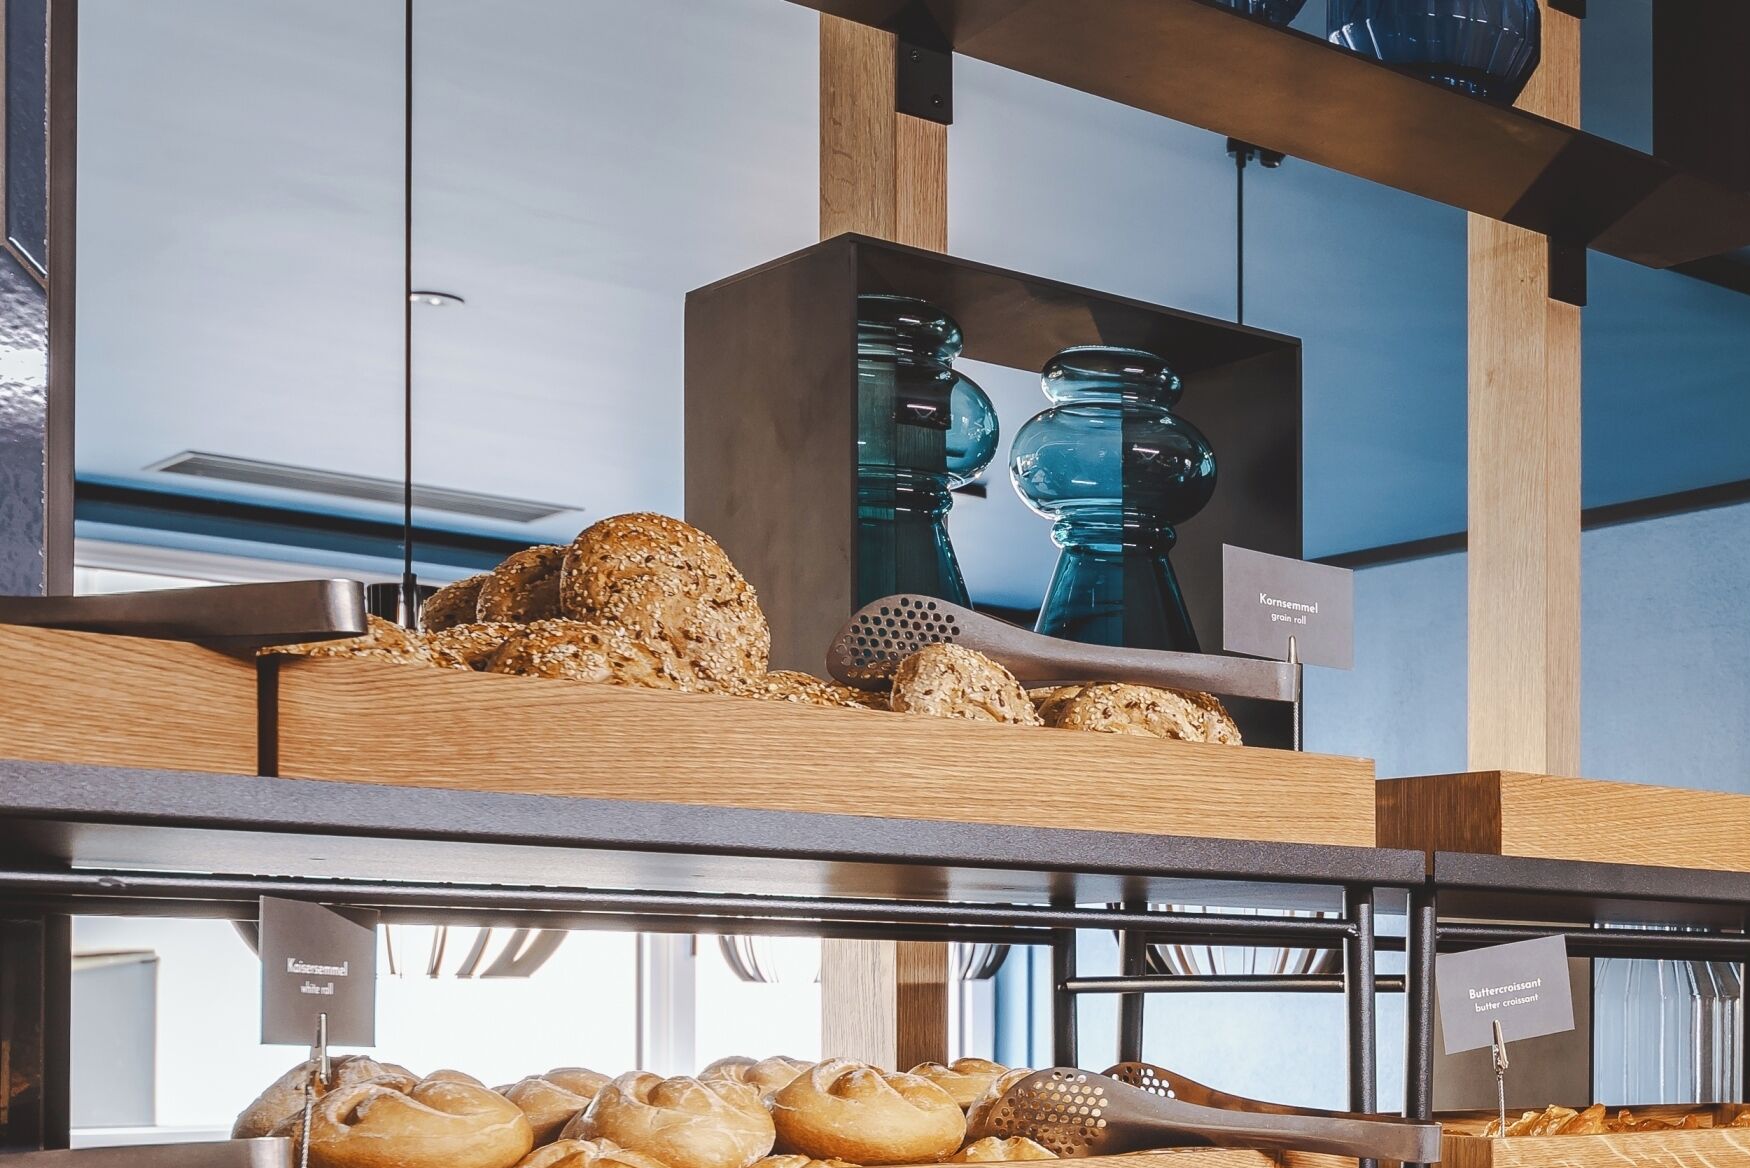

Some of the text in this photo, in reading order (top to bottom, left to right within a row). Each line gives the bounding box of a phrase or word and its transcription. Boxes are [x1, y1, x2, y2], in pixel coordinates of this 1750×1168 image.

[1259, 592, 1319, 614] Kornsemmel
[1271, 612, 1307, 625] grain roll
[287, 957, 349, 976] Kaisersemmel
[1468, 977, 1542, 1000] Buttercroissant
[1475, 994, 1539, 1013] butter croissant
